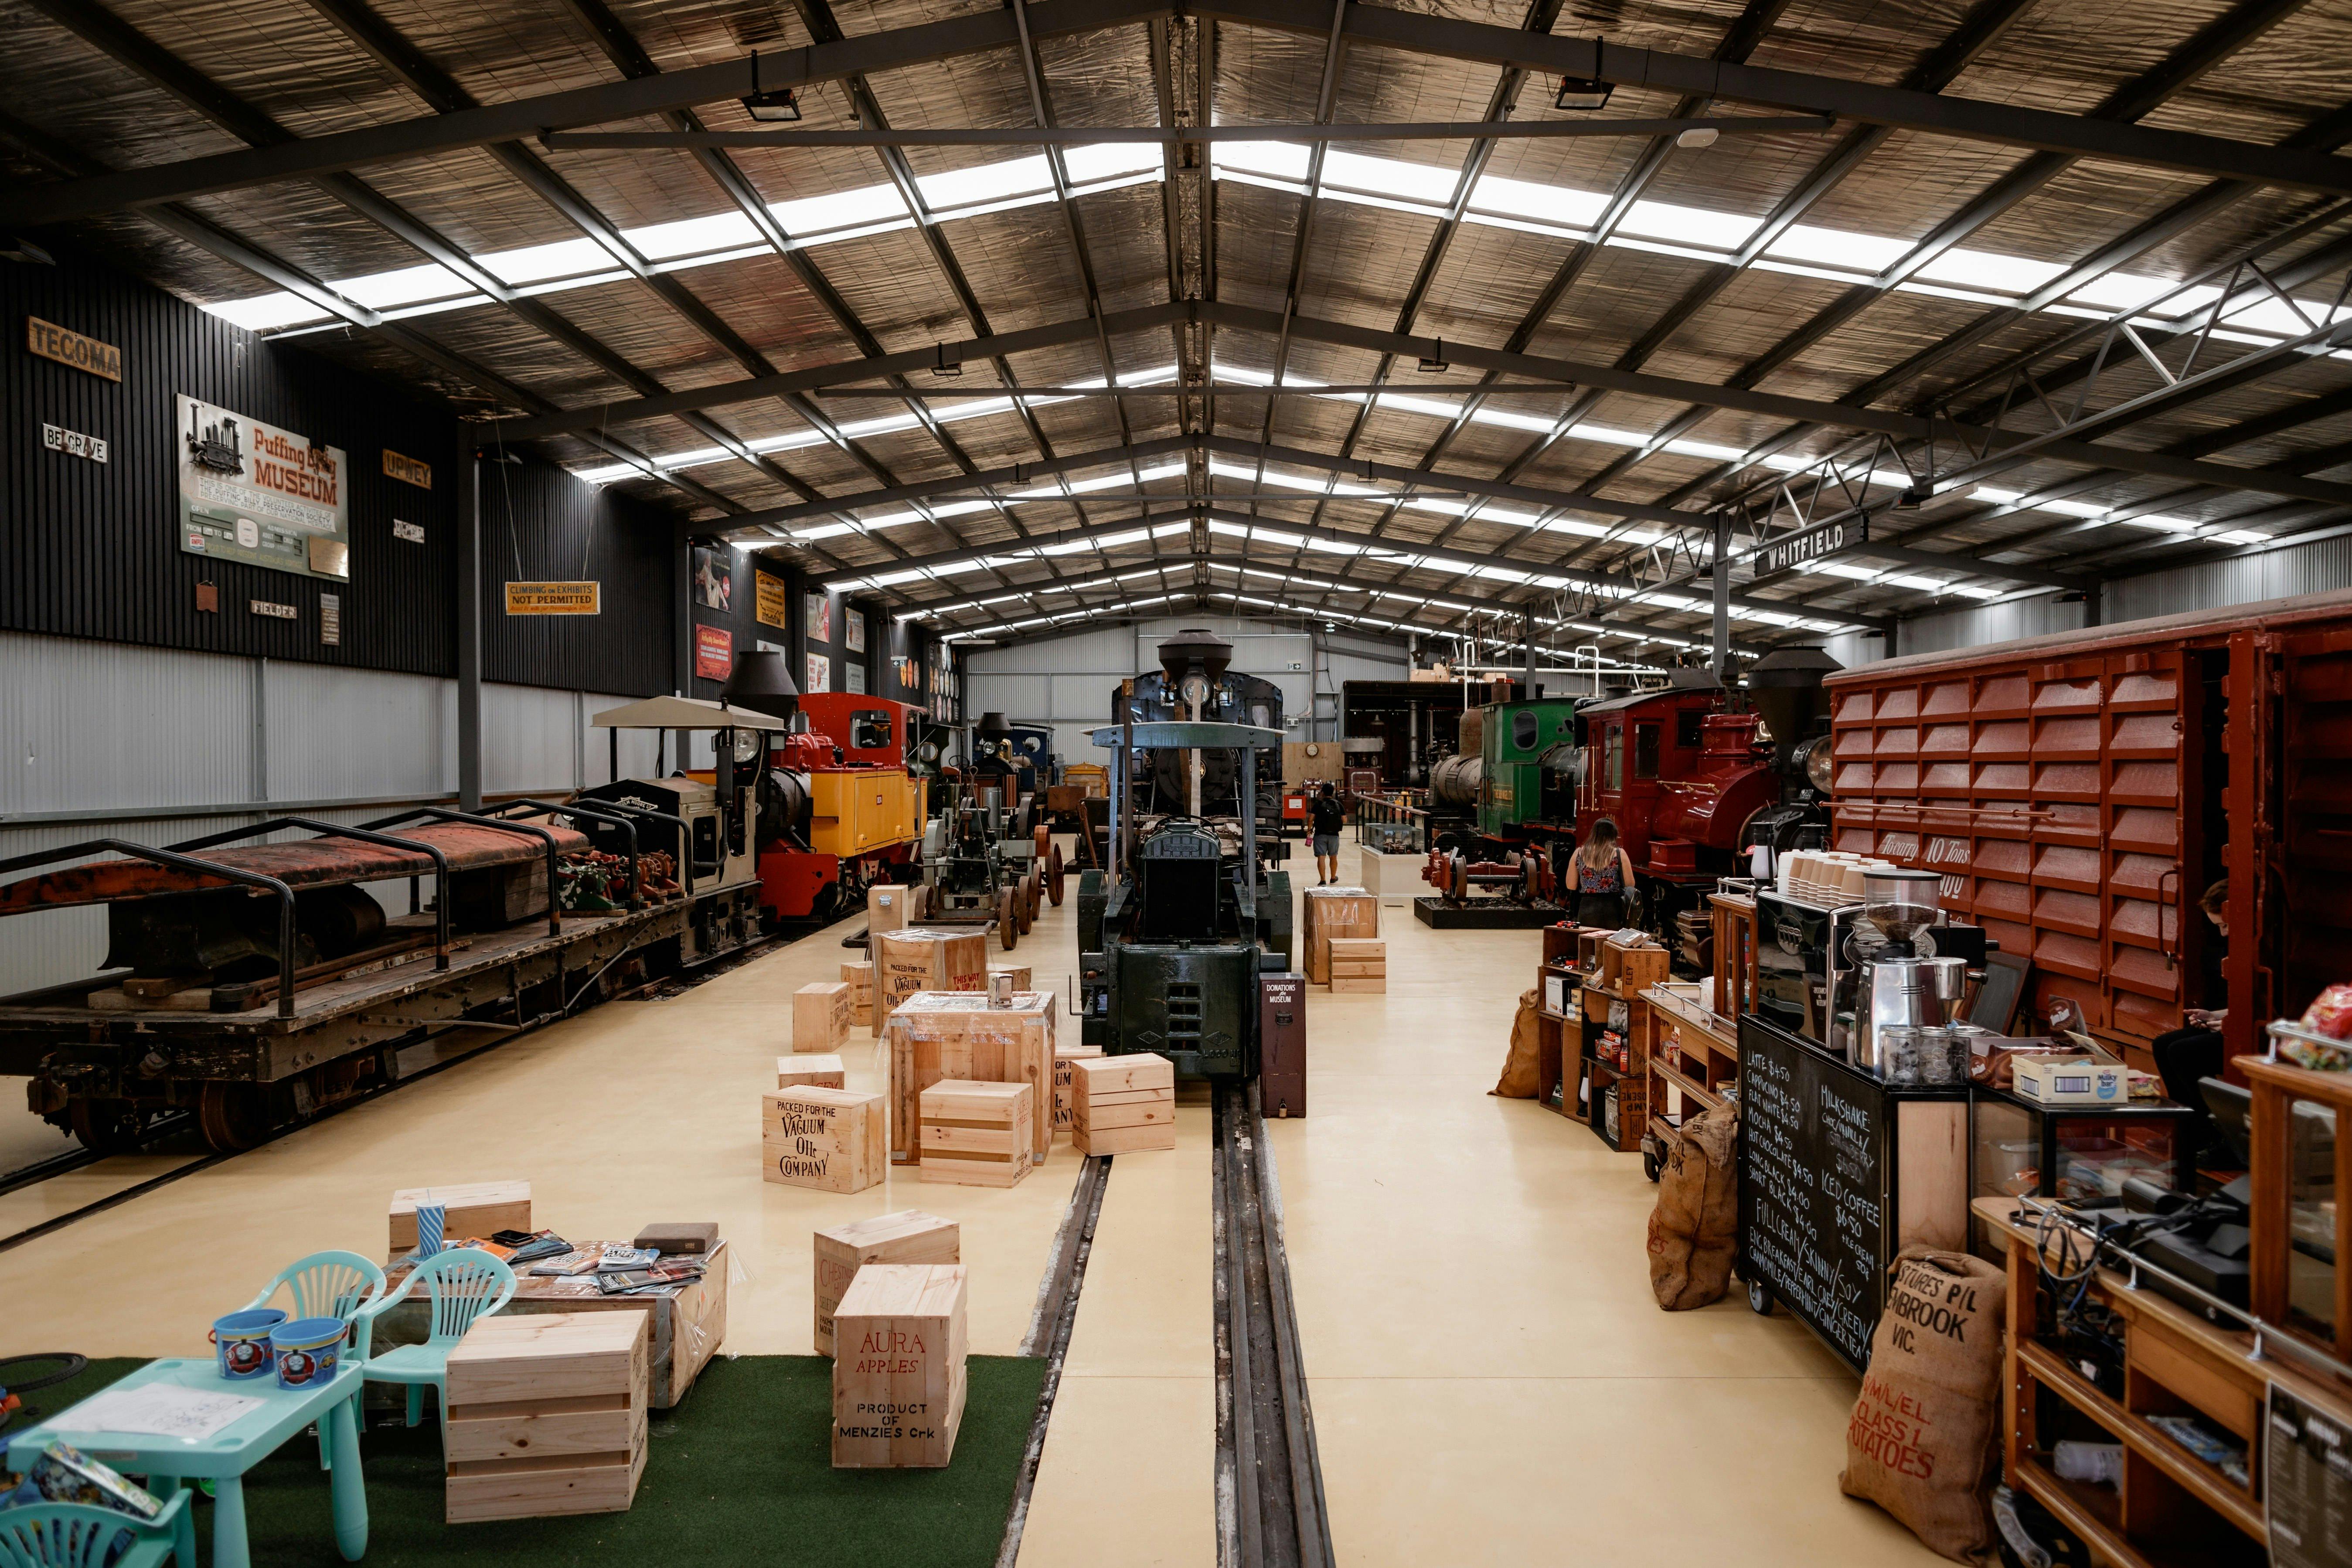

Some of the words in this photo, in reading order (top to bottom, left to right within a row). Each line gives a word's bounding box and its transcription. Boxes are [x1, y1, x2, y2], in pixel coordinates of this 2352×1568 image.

[33, 322, 119, 378] TECOMA
[48, 429, 103, 459] BEGRAVE
[254, 429, 305, 471] Puffing
[255, 459, 337, 506] MUSEUM
[387, 453, 429, 485] UPWEY
[191, 505, 209, 514] OPEN
[200, 478, 215, 487] THIS
[225, 485, 237, 493] ONE
[249, 491, 261, 500] THE
[263, 495, 295, 508] VOLUNTEER
[296, 505, 322, 517] ACTIVITIES
[200, 484, 212, 493] THE
[216, 488, 241, 500] PUFFING
[244, 496, 260, 506] BILLY
[264, 501, 304, 517] PRESERVATION
[201, 491, 238, 506] PRESERVING
[280, 513, 305, 524] NATIONAL
[308, 520, 332, 531] HERITAGE
[186, 524, 201, 533] FROM
[265, 524, 297, 537] ADMISSION
[1768, 524, 1843, 570] WHITFIELD
[254, 602, 295, 618] FIELDER
[513, 595, 532, 604] NOT
[538, 595, 591, 604] PERMITTED
[1926, 837, 1945, 864] 10
[1944, 840, 1971, 864] Tons
[894, 976, 921, 993] VACUUM
[953, 976, 967, 985] THIS
[968, 973, 980, 982] WAY
[1014, 976, 1025, 985] RA
[1055, 1061, 1066, 1069] OR
[1747, 1050, 1767, 1071] LATTE
[1768, 1057, 1790, 1082] $4.50
[1747, 1069, 1778, 1099] CAPPUCINO
[1780, 1085, 1800, 1112] $4.50
[777, 1101, 803, 1113] PACKED
[806, 1105, 820, 1115] FOR
[822, 1107, 836, 1117] THE
[1749, 1089, 1761, 1107] FLAT
[1762, 1099, 1780, 1119] WHITE
[1780, 1108, 1798, 1130] $4.50
[782, 1112, 825, 1138] VACUUM
[1749, 1106, 1771, 1134] MOCHA
[1774, 1125, 1793, 1150] $4.50
[796, 1137, 817, 1158] OIL
[1749, 1126, 1759, 1144] HOT
[1760, 1135, 1791, 1169] CHOCOLATE
[1793, 1159, 1813, 1187] $4.50
[779, 1151, 829, 1177] COMPANY
[1749, 1147, 1764, 1170] LONG
[1764, 1160, 1786, 1189] BLACK
[1787, 1178, 1810, 1210] $4.00
[1749, 1165, 1767, 1187] SHORT
[1769, 1179, 1792, 1213] BLACK
[1793, 1205, 1817, 1241] $4.00
[1822, 1168, 1842, 1201] ICED
[1844, 1188, 1879, 1228] COFFEE
[1756, 1197, 1776, 1234] FULL
[820, 1258, 854, 1287] CHESTNUT
[1855, 1244, 1874, 1271] CREAM
[1898, 1265, 1944, 1298] STURES
[1947, 1283, 1977, 1313] P/L
[1886, 1286, 1969, 1344] EMBROOK
[860, 1332, 925, 1354] AURA
[1848, 1330, 1862, 1360] TEA
[1892, 1323, 1915, 1355] VIC.
[856, 1359, 919, 1373] APPLES
[857, 1403, 928, 1414] PRODUCT
[882, 1416, 900, 1426] OF
[1856, 1400, 1909, 1440] CLASS
[839, 1427, 902, 1439] MENZIES
[909, 1428, 935, 1439] Crk
